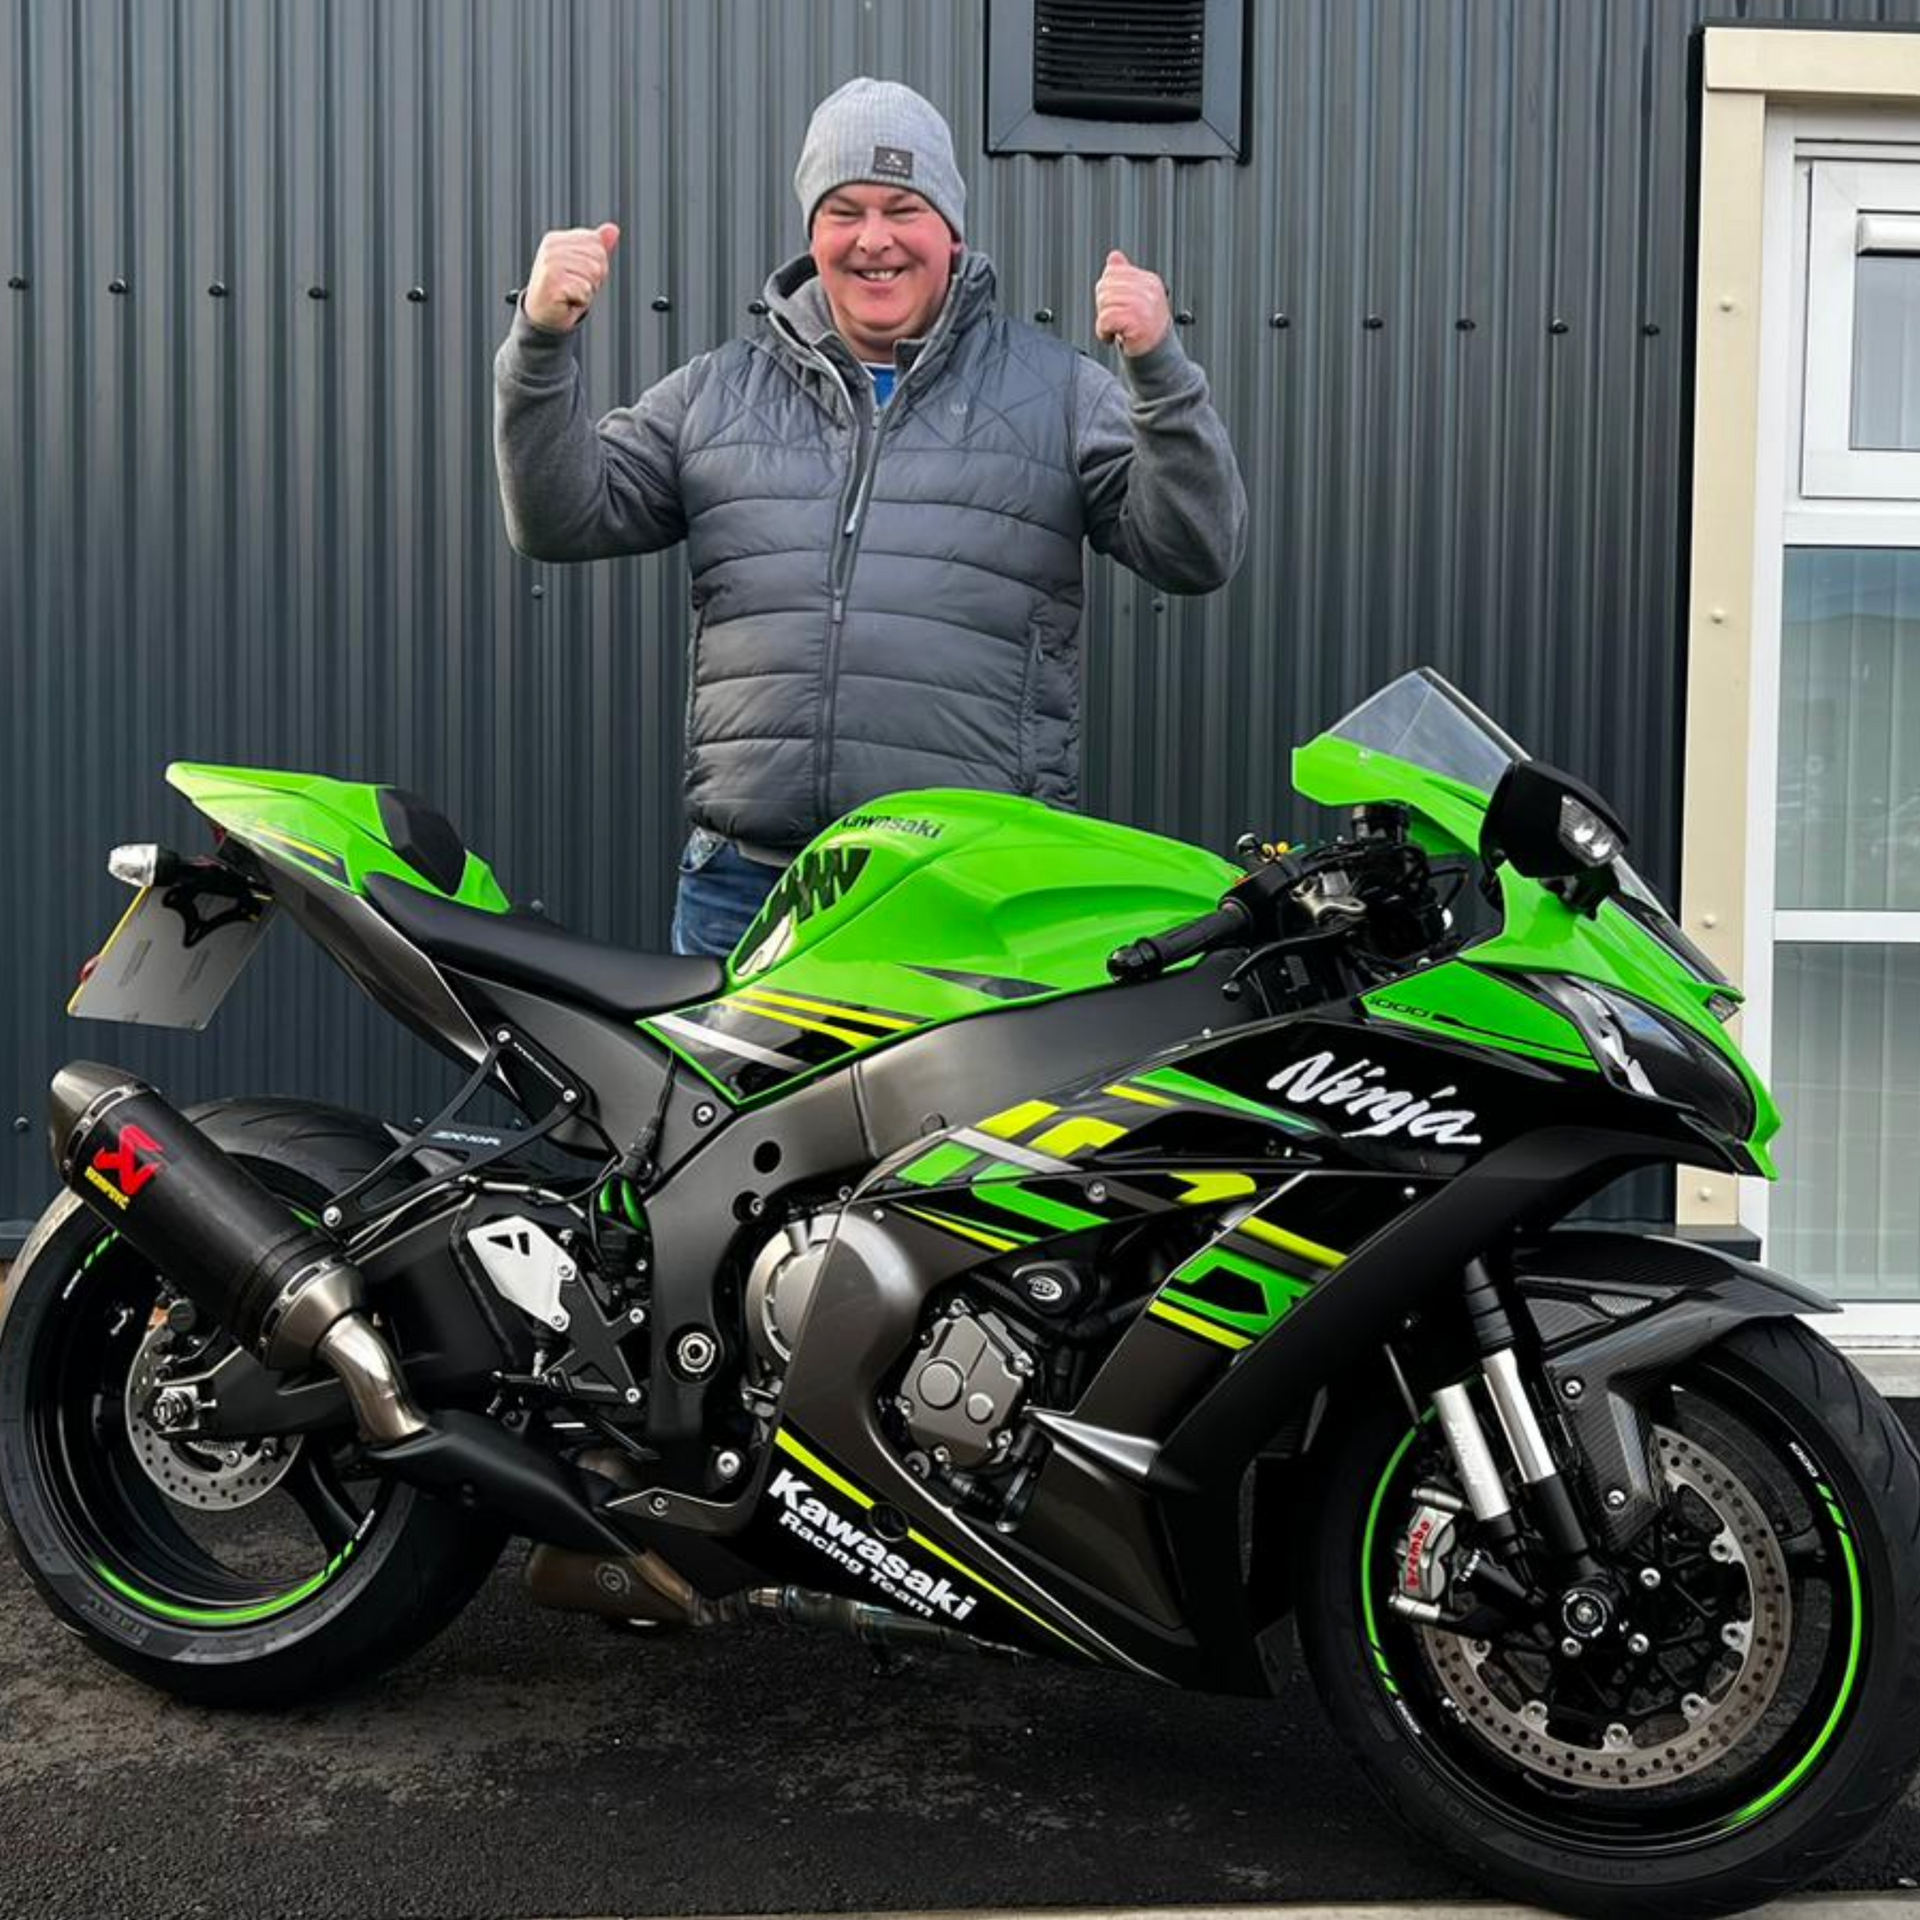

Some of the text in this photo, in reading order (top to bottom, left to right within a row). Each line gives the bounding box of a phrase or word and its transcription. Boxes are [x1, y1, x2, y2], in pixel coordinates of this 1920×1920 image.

[1267, 1051, 1482, 1144] Ninja
[768, 1468, 978, 1621] Kawasaki
[778, 1510, 935, 1618] Racing Team
[1405, 1519, 1431, 1588] brembo
